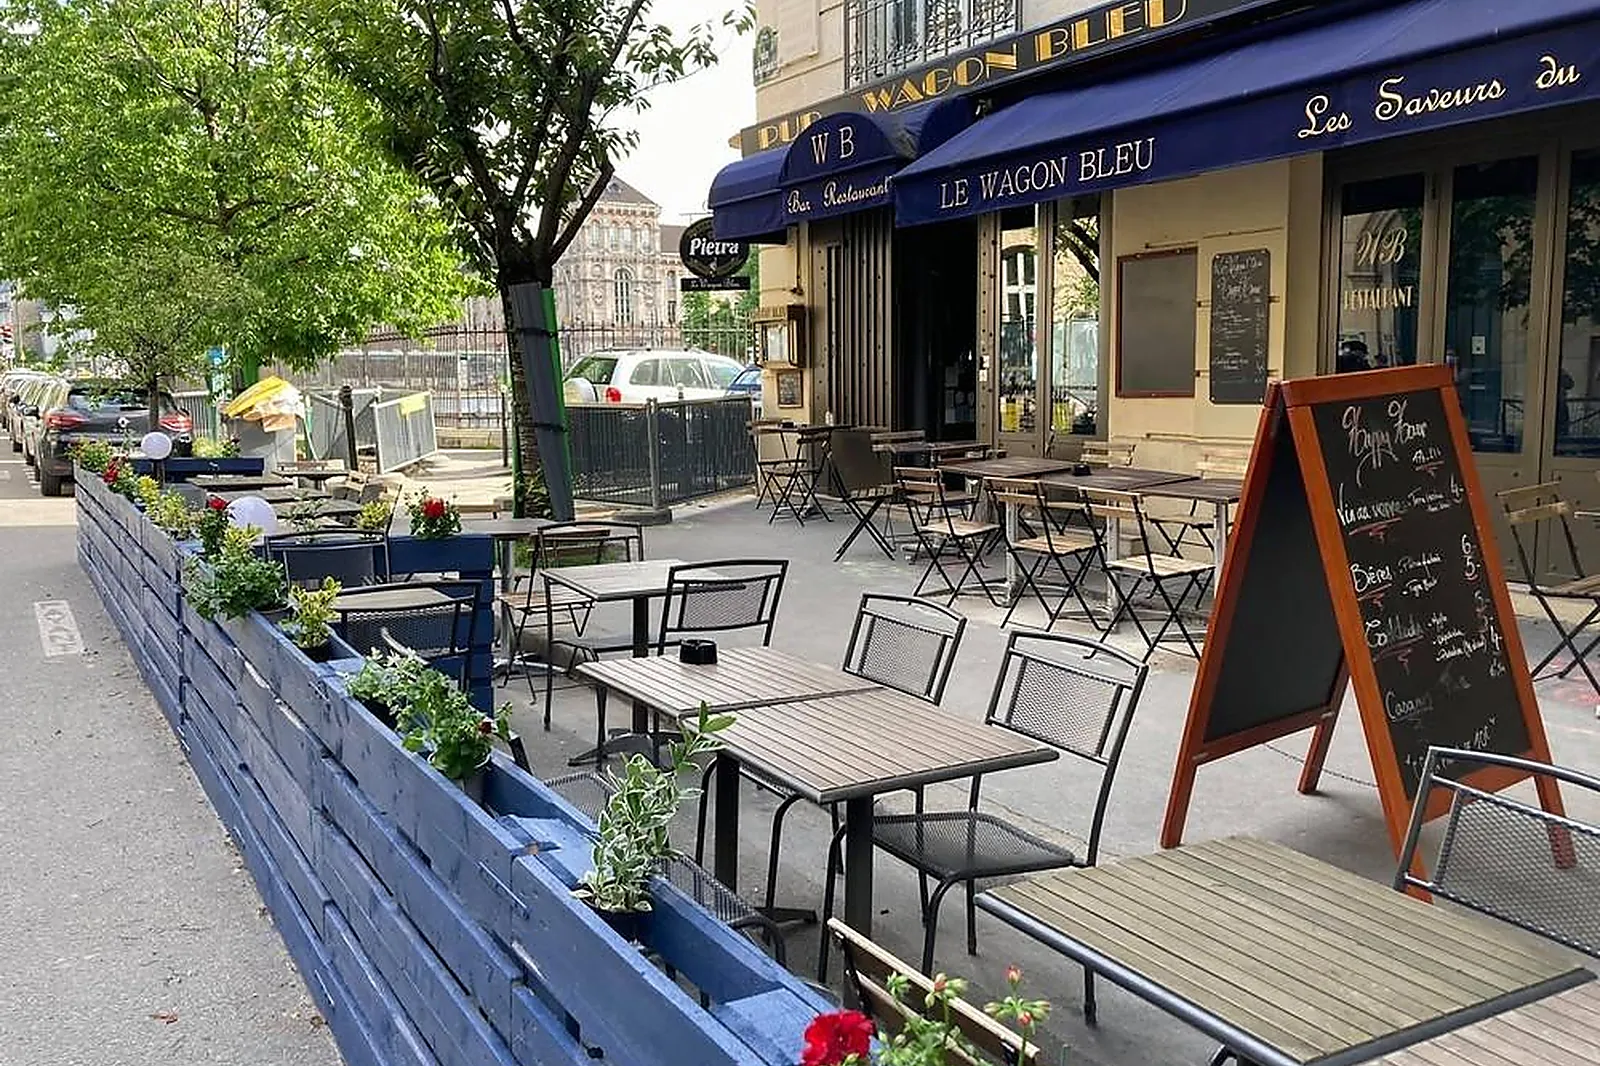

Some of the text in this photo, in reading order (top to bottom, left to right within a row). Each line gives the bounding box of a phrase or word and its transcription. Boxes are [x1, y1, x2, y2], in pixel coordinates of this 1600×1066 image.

[861, 43, 1018, 113] WAGON
[1034, 0, 1187, 62] BLEU
[1297, 54, 1581, 139] Les Saveurs du
[788, 175, 893, 215] Bar Restaurant
[940, 137, 1156, 209] LE WAGON BLEU
[689, 237, 740, 256] Pietra
